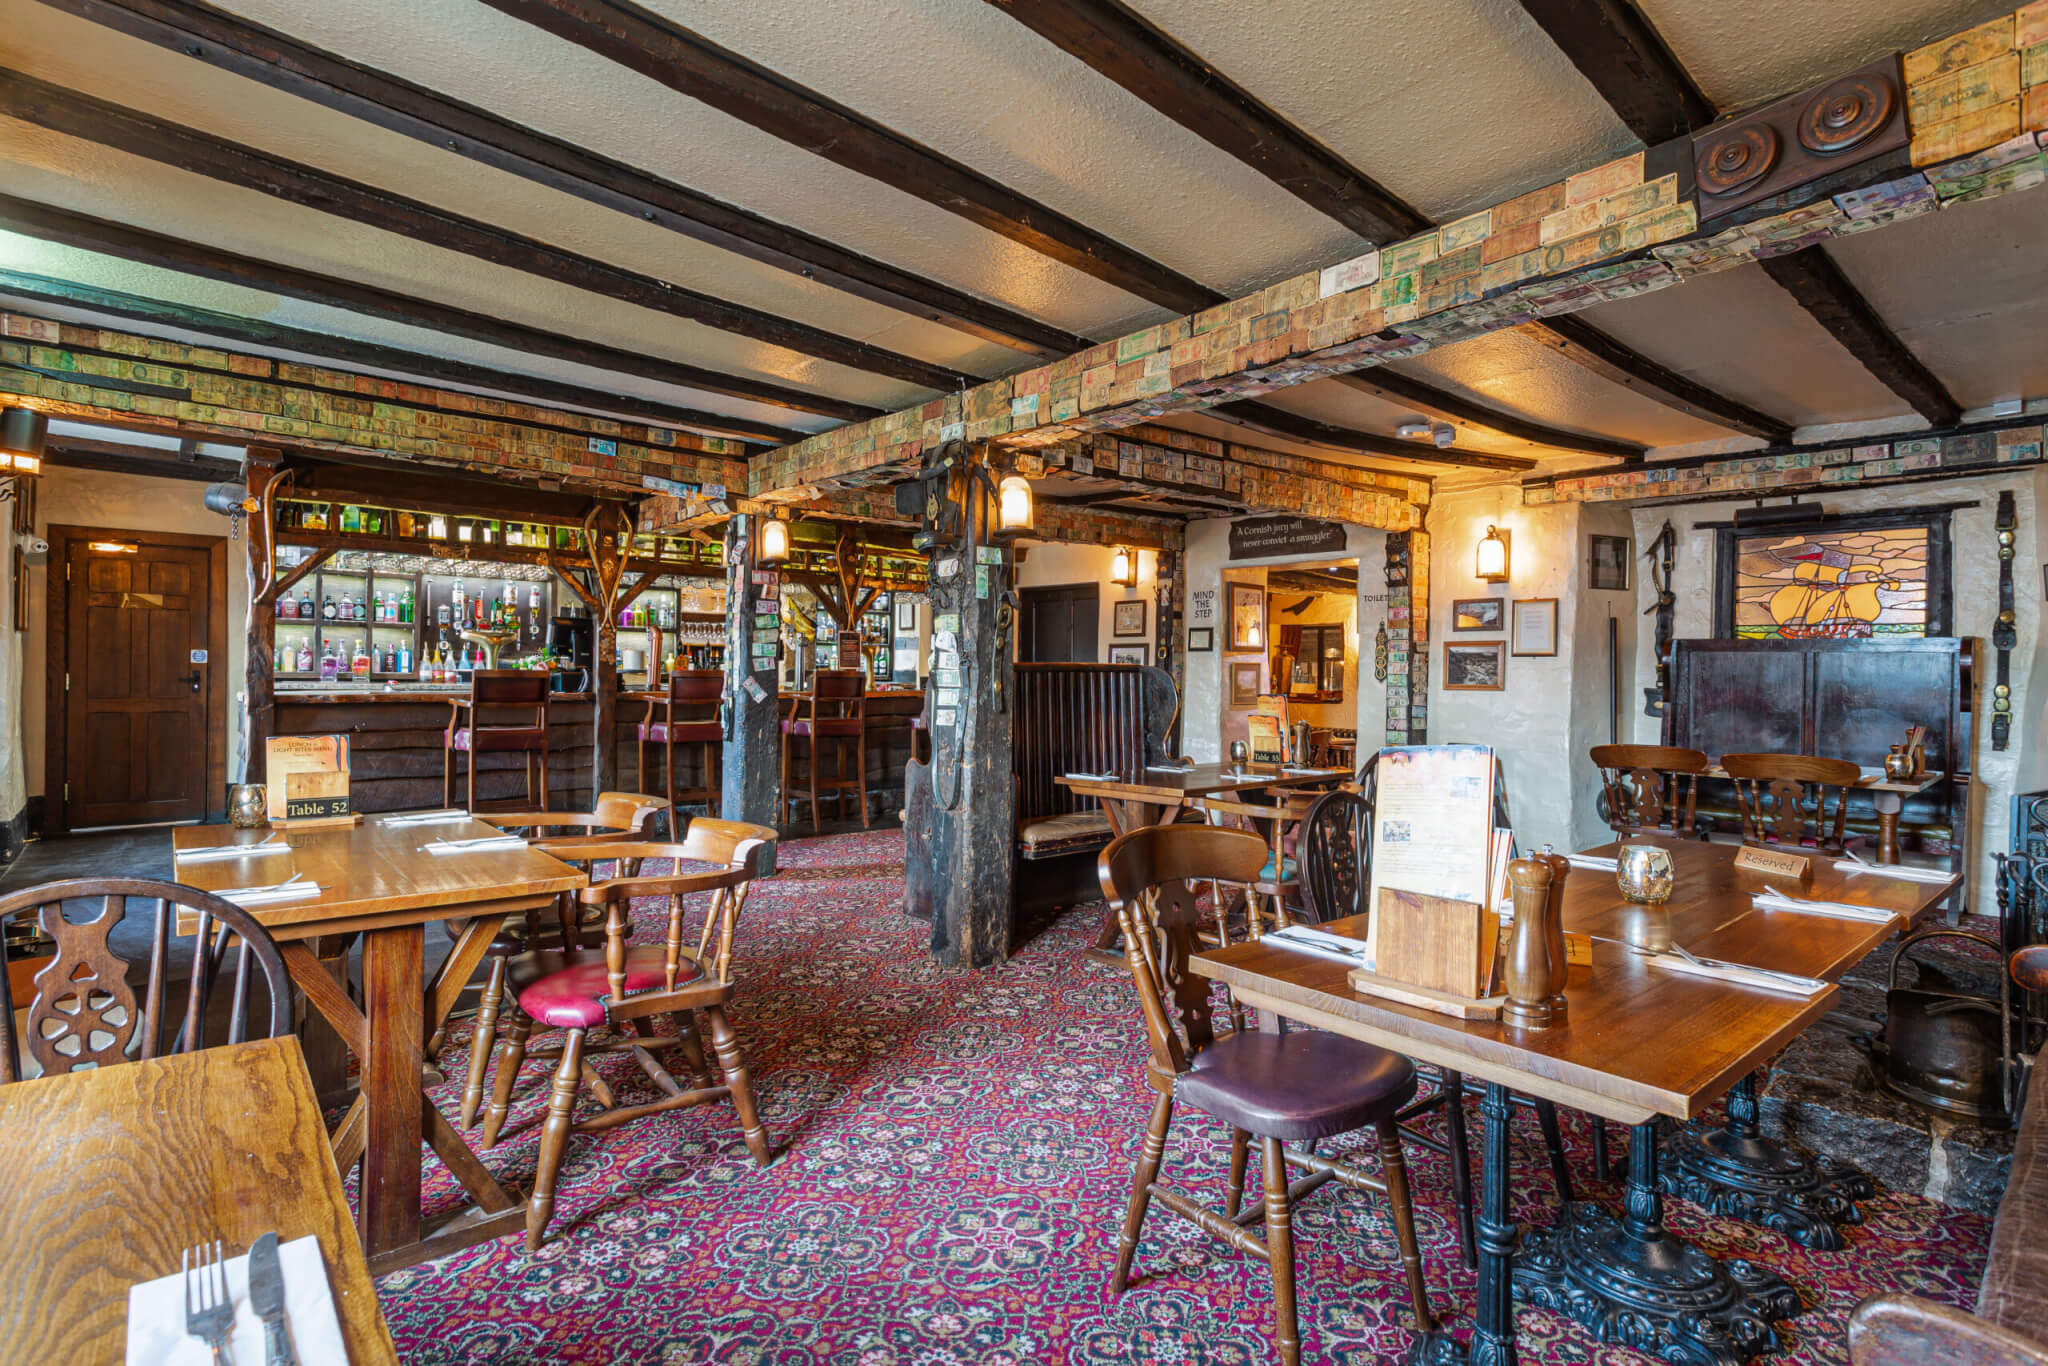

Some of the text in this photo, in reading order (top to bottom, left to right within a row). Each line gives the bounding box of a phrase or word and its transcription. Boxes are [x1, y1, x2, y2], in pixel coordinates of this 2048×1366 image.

[1244, 523, 1272, 535] Cornish
[1272, 522, 1289, 534] jury
[1290, 520, 1303, 530] will
[1243, 538, 1262, 548] never
[1262, 535, 1287, 545] convict
[1193, 591, 1215, 600] MIND
[1195, 600, 1210, 608] THE
[1194, 609, 1213, 618] STEP
[1255, 753, 1270, 761] Table
[288, 802, 347, 816] Table 52
[1743, 851, 1795, 872] Reserved
